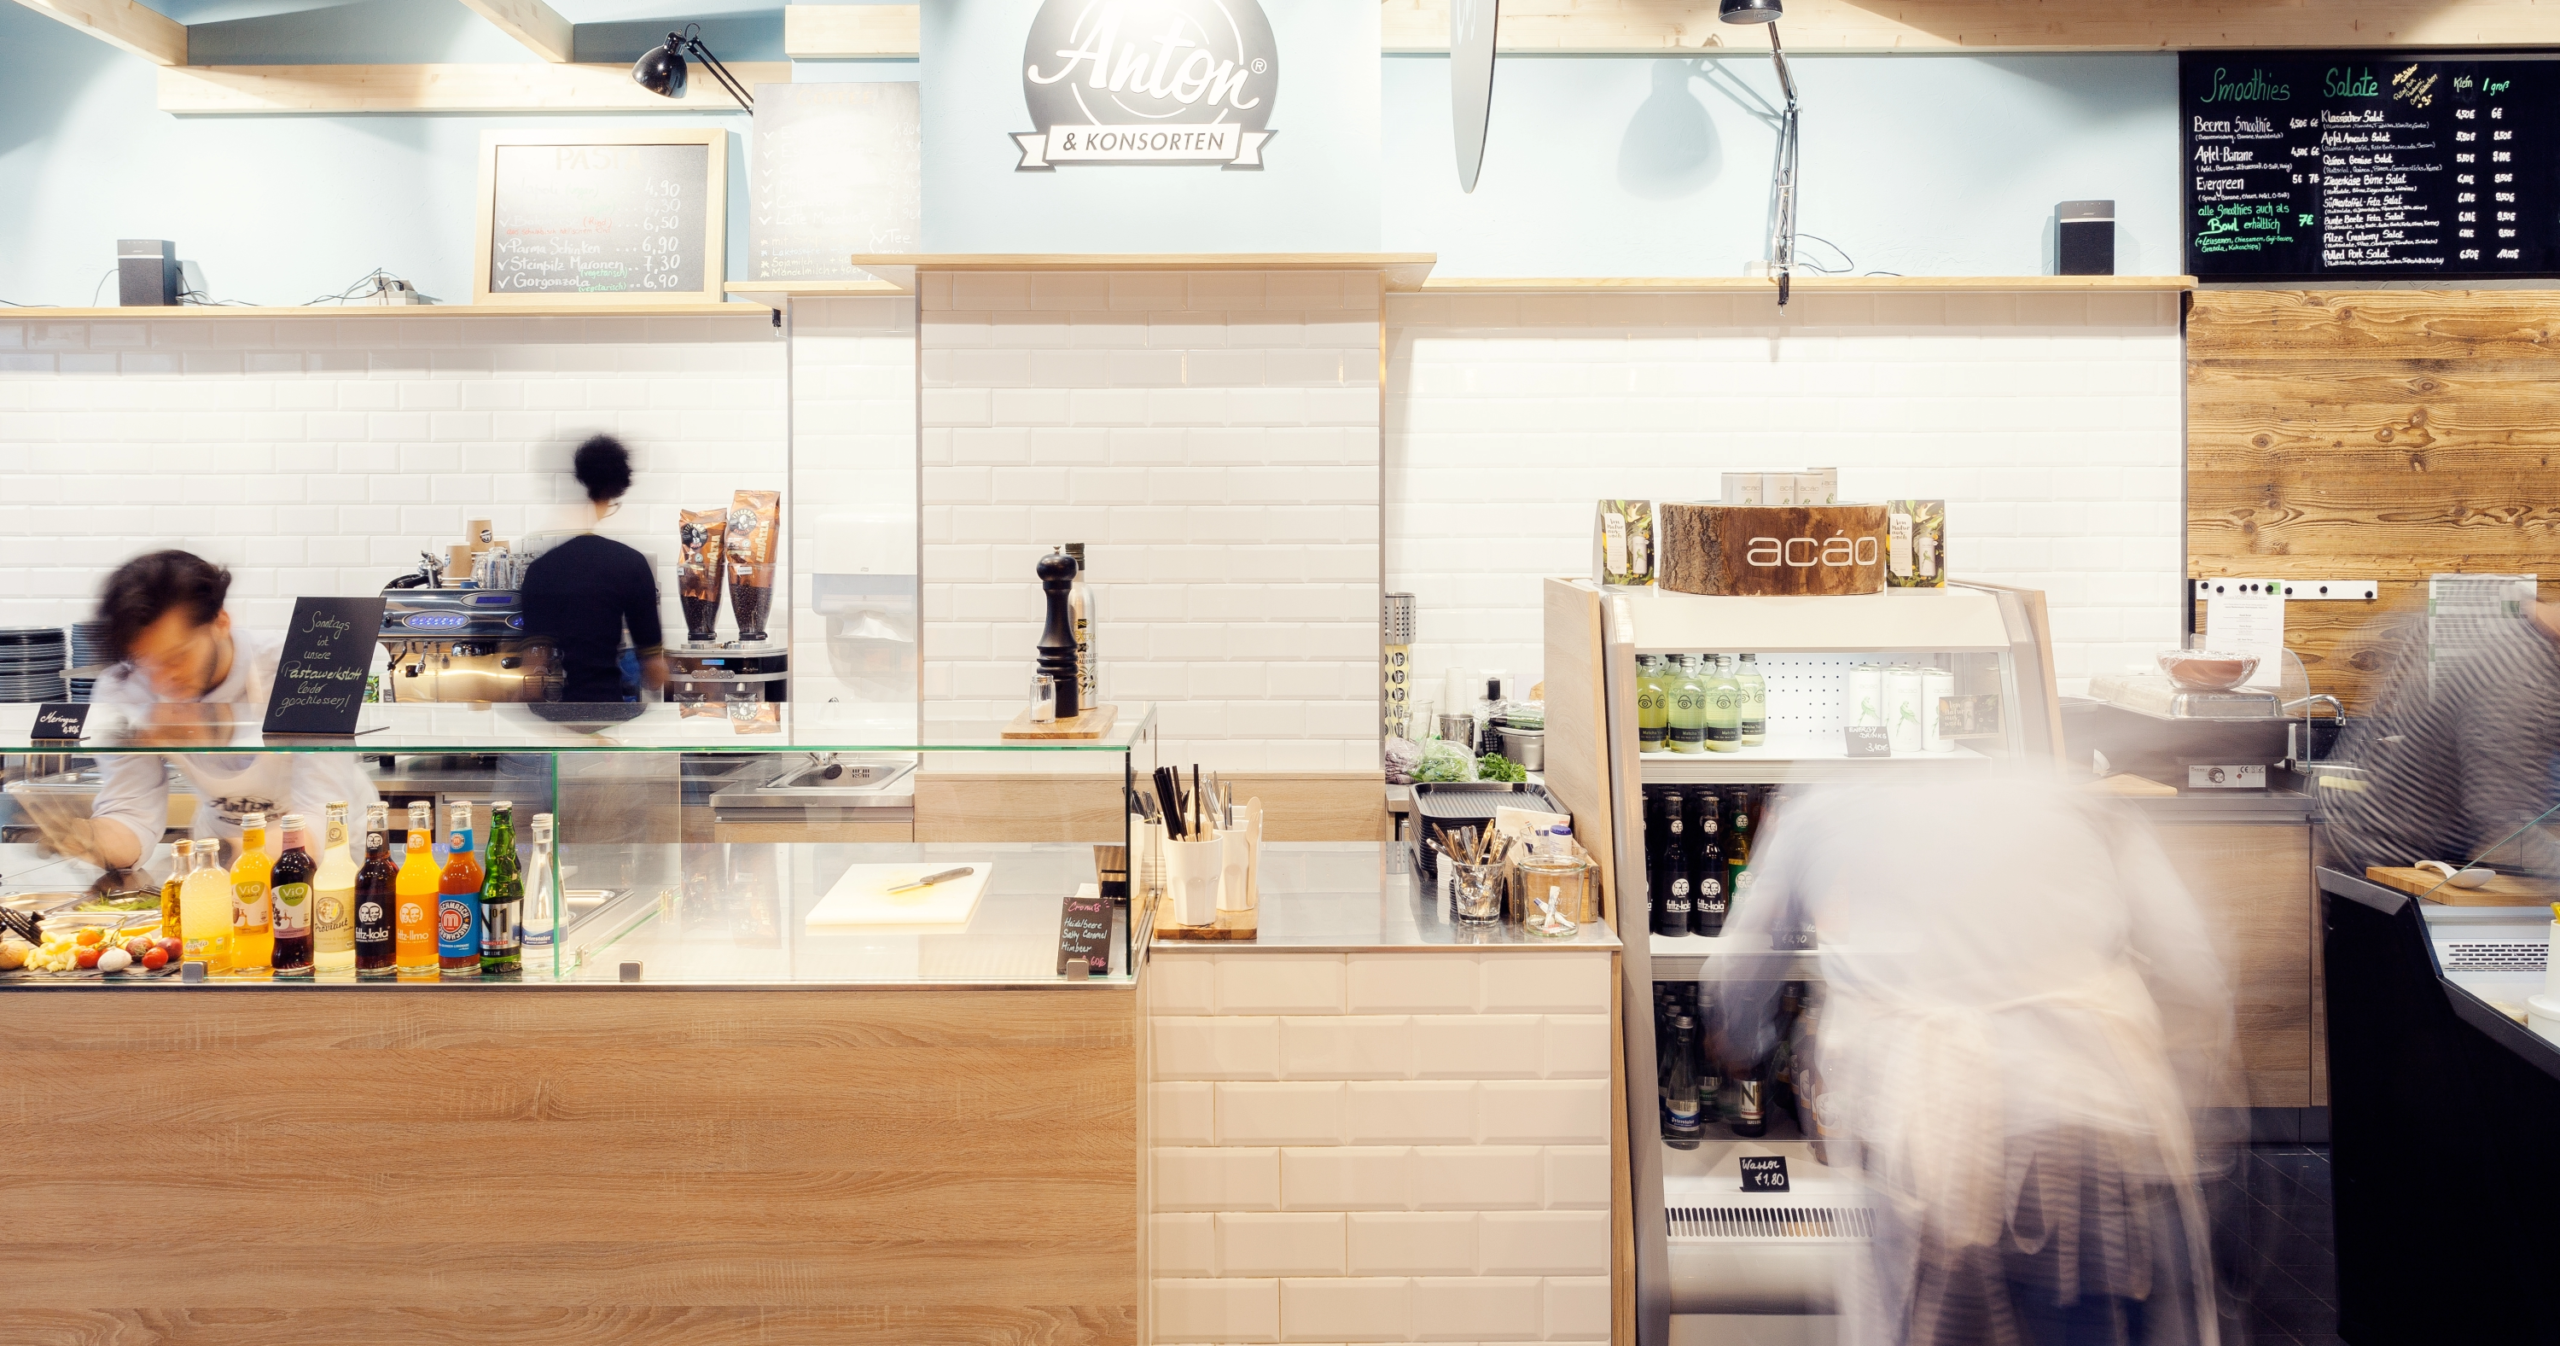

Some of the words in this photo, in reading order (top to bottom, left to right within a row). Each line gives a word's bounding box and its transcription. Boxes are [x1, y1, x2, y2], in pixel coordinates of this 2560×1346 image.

[1028, 0, 1260, 110] Anton
[2200, 67, 2290, 103] Smoothies
[2323, 67, 2379, 97] Salate
[2490, 80, 2510, 96] groß
[2321, 109, 2362, 123] Klassischer
[2362, 109, 2384, 123] Salat
[2491, 107, 2502, 119] 6€
[2194, 115, 2230, 132] Beeren
[2234, 115, 2273, 132] Smoothie
[1062, 132, 1077, 151] &
[1085, 132, 1225, 151] KONSORTEN
[2321, 131, 2342, 146] Apfel
[2371, 131, 2391, 142] Salat
[2194, 145, 2254, 164] Apfel-Banane
[2374, 153, 2393, 163] Salat
[644, 177, 680, 197] 4,90
[2196, 177, 2244, 197] Evergreen
[2363, 174, 2383, 185] Birne
[2385, 173, 2407, 185] Salat
[2383, 194, 2402, 206] Salat
[2198, 205, 2214, 216] alle
[2216, 203, 2252, 219] Smoothies
[2256, 202, 2273, 216] auch
[2276, 203, 2290, 213] als
[2366, 213, 2382, 222] Feta
[2384, 211, 2405, 221] Salat
[643, 215, 679, 232] 6,50
[2207, 217, 2239, 232] Bowl
[2243, 216, 2280, 234] erhältlich
[2298, 214, 2314, 227] 7€
[886, 228, 912, 244] Tee
[2323, 232, 2343, 243] Pilze
[2382, 229, 2404, 239] Salat
[508, 238, 547, 254] Parma
[550, 237, 600, 255] Schinken
[641, 235, 679, 254] 6,90
[2323, 249, 2345, 260] Pulled
[2347, 248, 2364, 258] Pork
[2365, 247, 2390, 258] Salat
[510, 256, 565, 275] Steinpilz
[570, 256, 624, 271] Maronen
[643, 254, 681, 274] 7,30
[771, 256, 813, 270] Sojamilch
[771, 264, 830, 278] Mandelmilch
[513, 272, 590, 289] Gorgonzola
[643, 273, 679, 289] 6,90
[1746, 529, 1878, 568] acáo
[302, 610, 351, 640] Sonntags
[317, 635, 330, 647] ist
[303, 650, 332, 660] unsere
[281, 660, 363, 681] Pastawerkstatt
[297, 680, 328, 694] leider
[1063, 917, 1103, 929] Heidelbeere
[1061, 941, 1093, 953] Himbeer
[1754, 1172, 1785, 1187] €1,80
